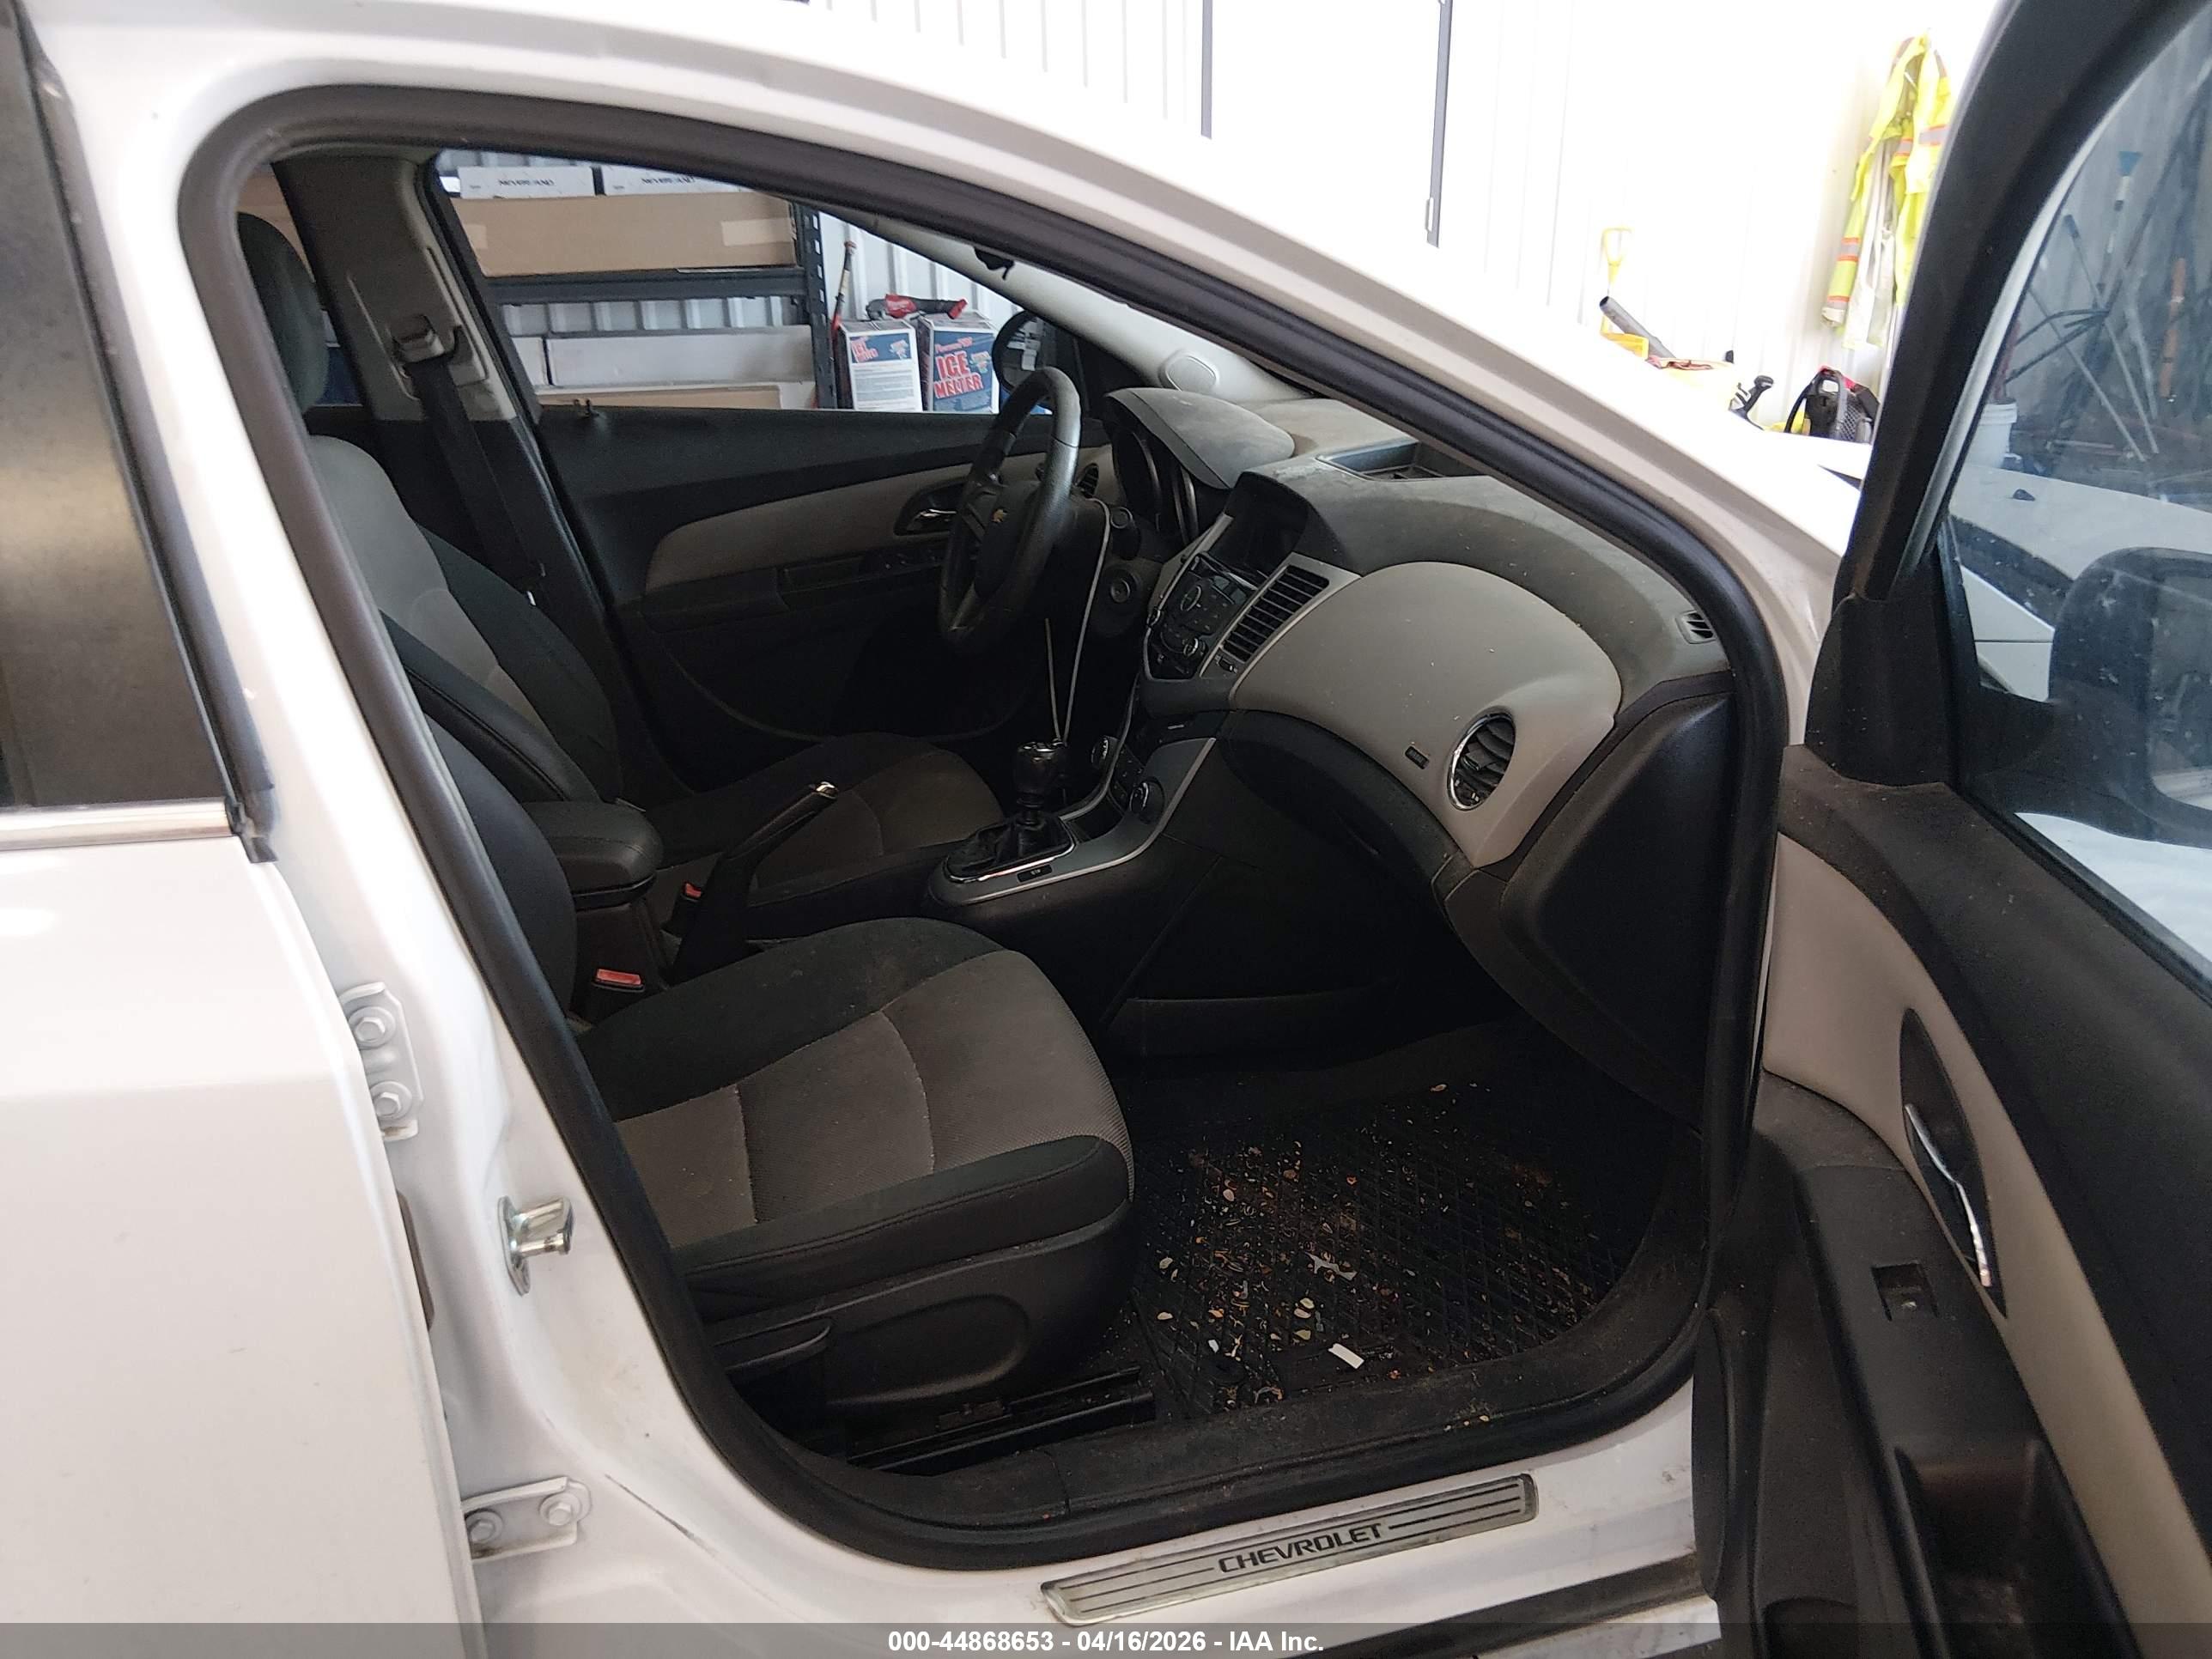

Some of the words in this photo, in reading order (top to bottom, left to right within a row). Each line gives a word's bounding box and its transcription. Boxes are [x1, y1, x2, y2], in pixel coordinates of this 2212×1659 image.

[936, 350, 970, 379] ICE
[933, 372, 983, 399] MELTER
[1218, 1522, 1382, 1573] CHEVROLET
